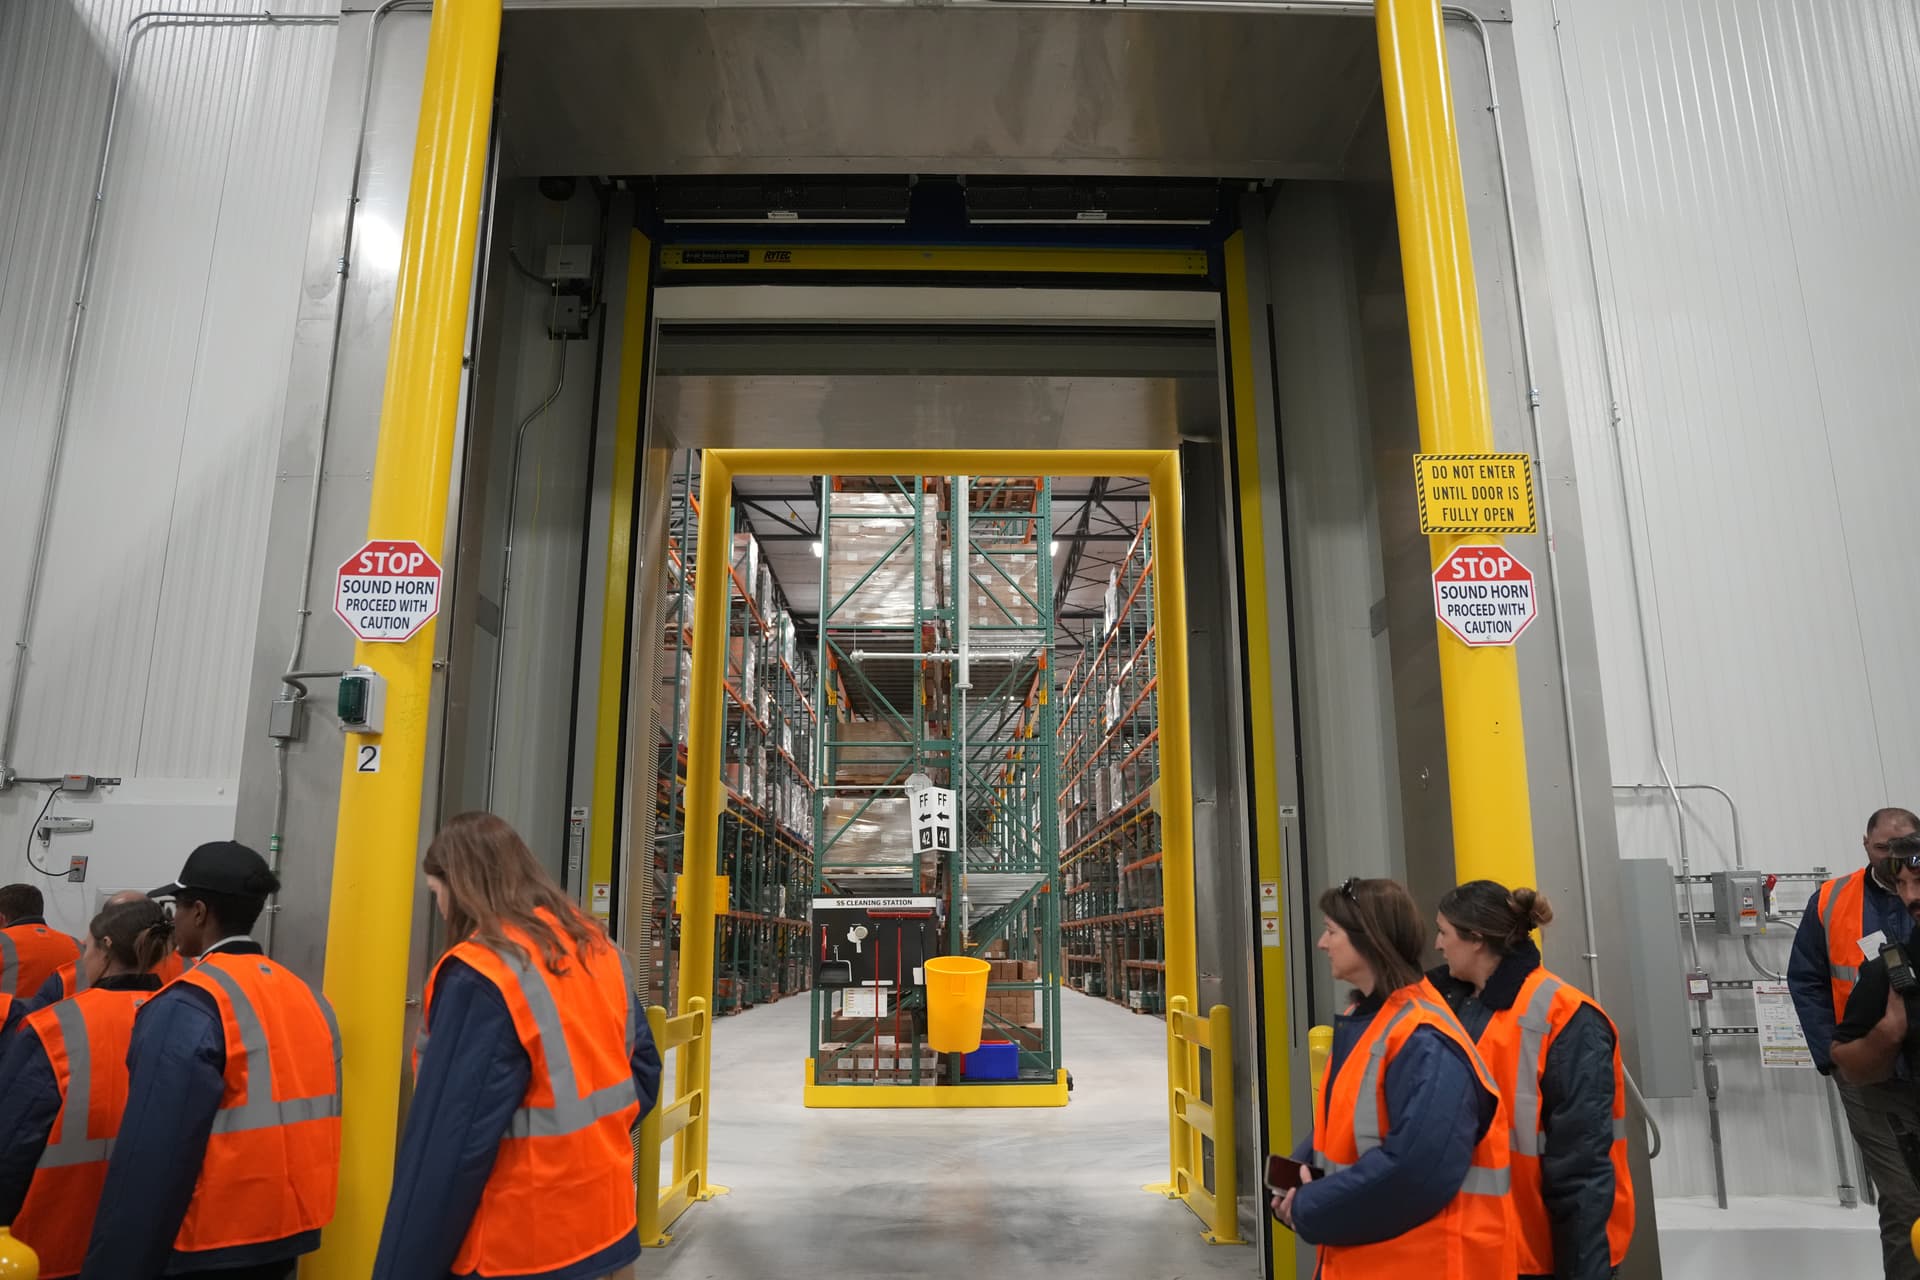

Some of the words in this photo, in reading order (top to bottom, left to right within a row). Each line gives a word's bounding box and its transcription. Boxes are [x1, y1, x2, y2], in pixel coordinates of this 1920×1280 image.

[1432, 465, 1447, 479] DO
[1453, 465, 1475, 479] NOT
[1480, 465, 1515, 479] ENTER
[1433, 486, 1467, 500] UNTIL
[1472, 486, 1503, 500] DOOR
[1508, 486, 1519, 500] IS
[1443, 507, 1478, 521] FULLY
[1484, 507, 1514, 521] OPEN
[358, 551, 424, 574] STOP
[1451, 557, 1513, 579] STOP
[343, 579, 392, 594] SOUND
[395, 580, 435, 595] HORN
[1441, 585, 1488, 599] SOUND
[1491, 584, 1529, 598] HORN
[346, 598, 397, 612] PROCEED
[399, 599, 428, 612] WITH
[1448, 603, 1496, 616] PROCEED
[1498, 602, 1526, 616] WITH
[360, 616, 410, 629] CAUTION
[1464, 620, 1512, 634] CAUTION
[359, 745, 377, 772] 2
[919, 793, 928, 808] FF
[938, 792, 947, 807] FF
[922, 831, 931, 845] 42
[939, 830, 947, 845] 41
